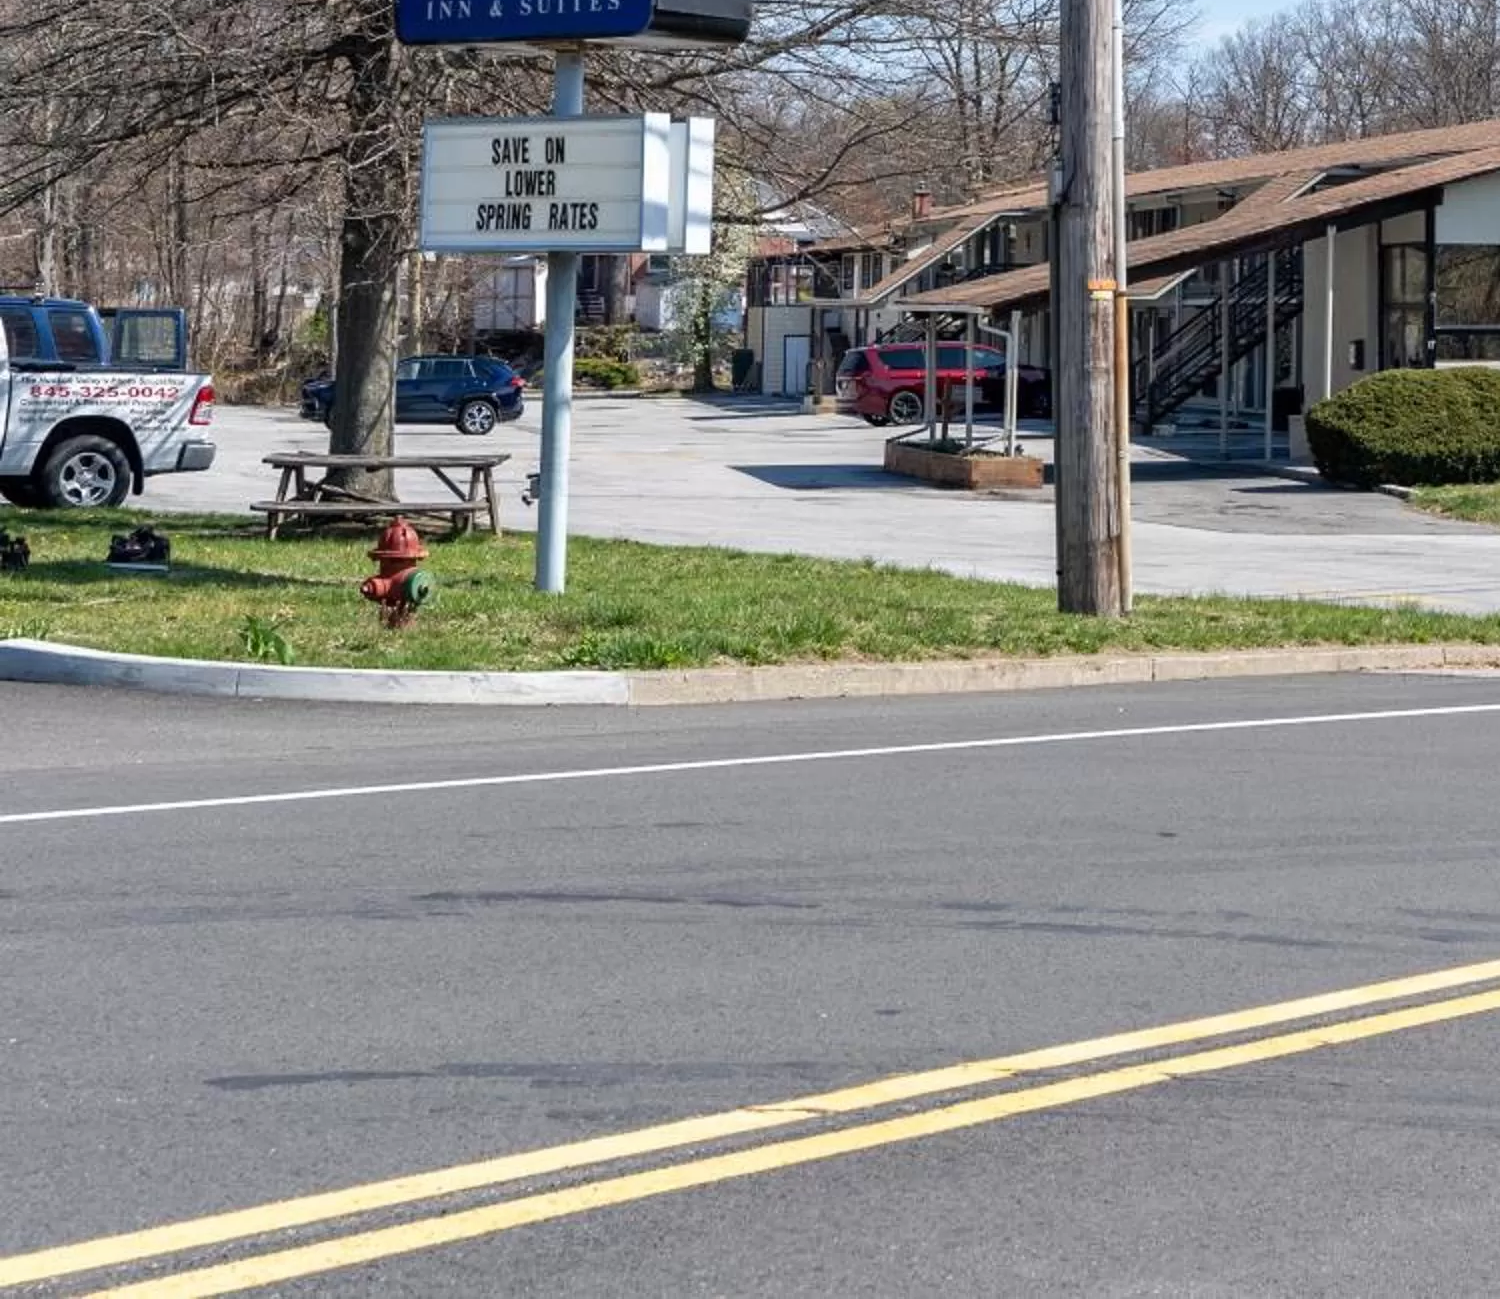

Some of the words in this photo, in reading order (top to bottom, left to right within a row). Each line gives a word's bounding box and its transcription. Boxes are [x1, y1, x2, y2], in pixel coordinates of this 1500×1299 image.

[427, 0, 471, 20] INN
[489, 0, 503, 17] &
[491, 138, 530, 165] SAVE
[545, 137, 566, 163] ON
[505, 171, 556, 196] LOWER
[476, 204, 532, 230] SPRING
[549, 203, 599, 230] RATES
[30, 386, 179, 398] 845-325-0042
